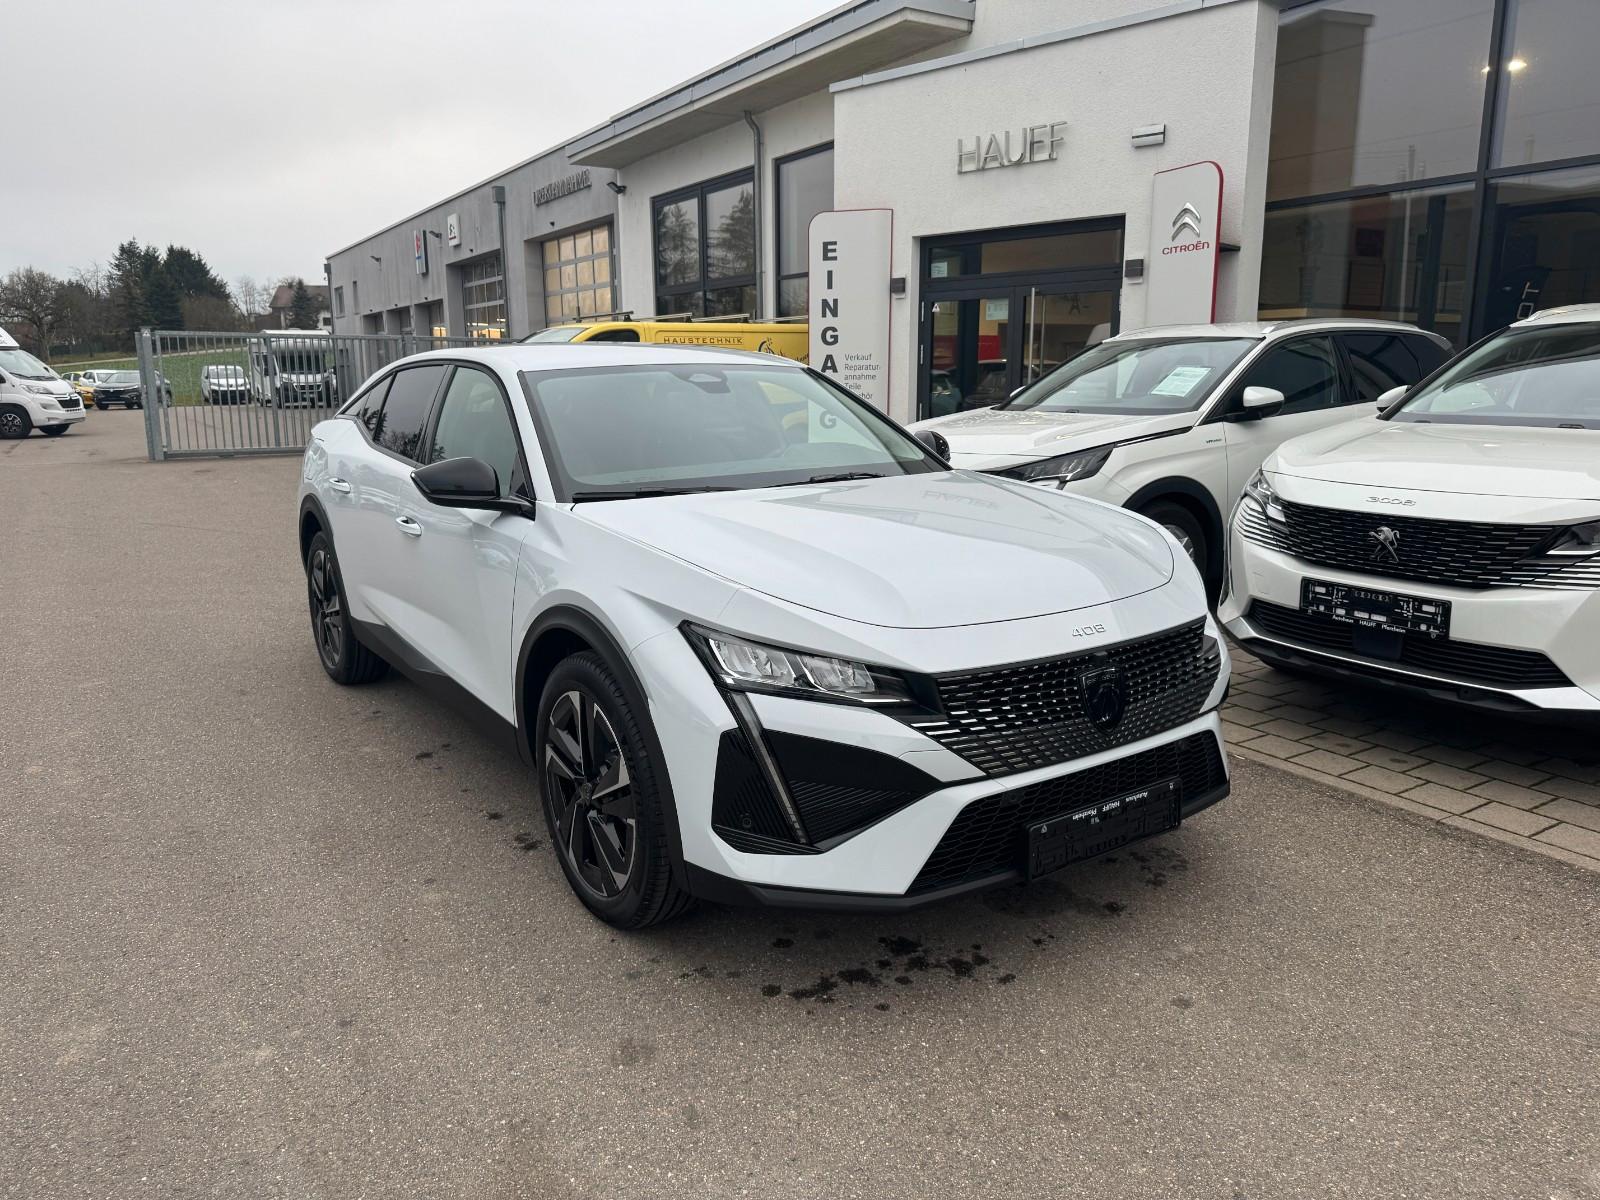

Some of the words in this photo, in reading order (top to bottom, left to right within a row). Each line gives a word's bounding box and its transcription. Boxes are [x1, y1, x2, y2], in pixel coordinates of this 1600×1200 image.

[958, 121, 1067, 174] HAUFF
[663, 336, 744, 345] HAUSTECHNIK
[845, 352, 872, 361] Verkauf
[844, 373, 877, 381] annahme
[1366, 496, 1416, 506] 3008
[1072, 624, 1106, 636] 408
